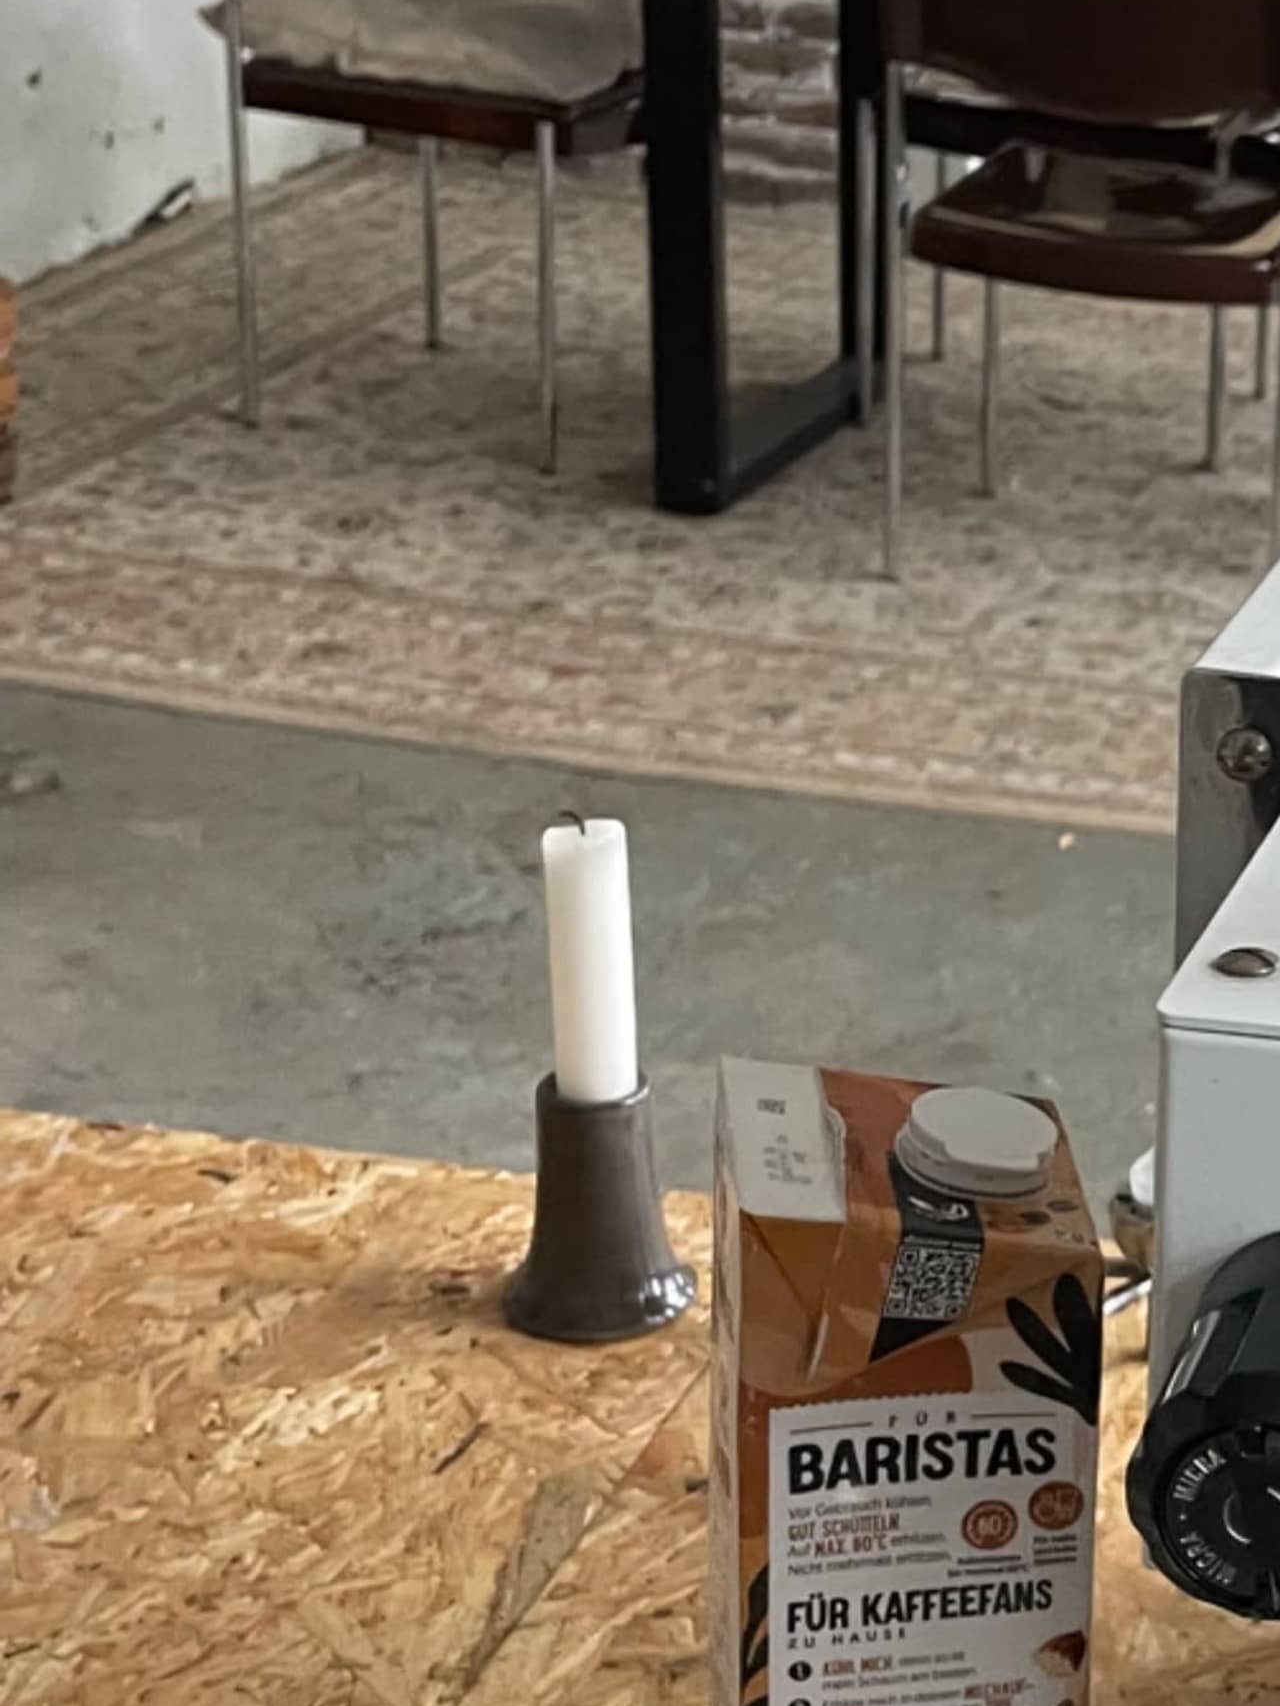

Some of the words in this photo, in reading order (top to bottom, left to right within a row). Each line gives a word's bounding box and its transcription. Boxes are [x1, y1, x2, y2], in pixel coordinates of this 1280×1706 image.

[788, 1426, 1057, 1496] BARISTAS
[1172, 1449, 1227, 1502] MICRA
[787, 1592, 849, 1634] FÜR
[861, 1579, 1054, 1627] KAFFEEFANS
